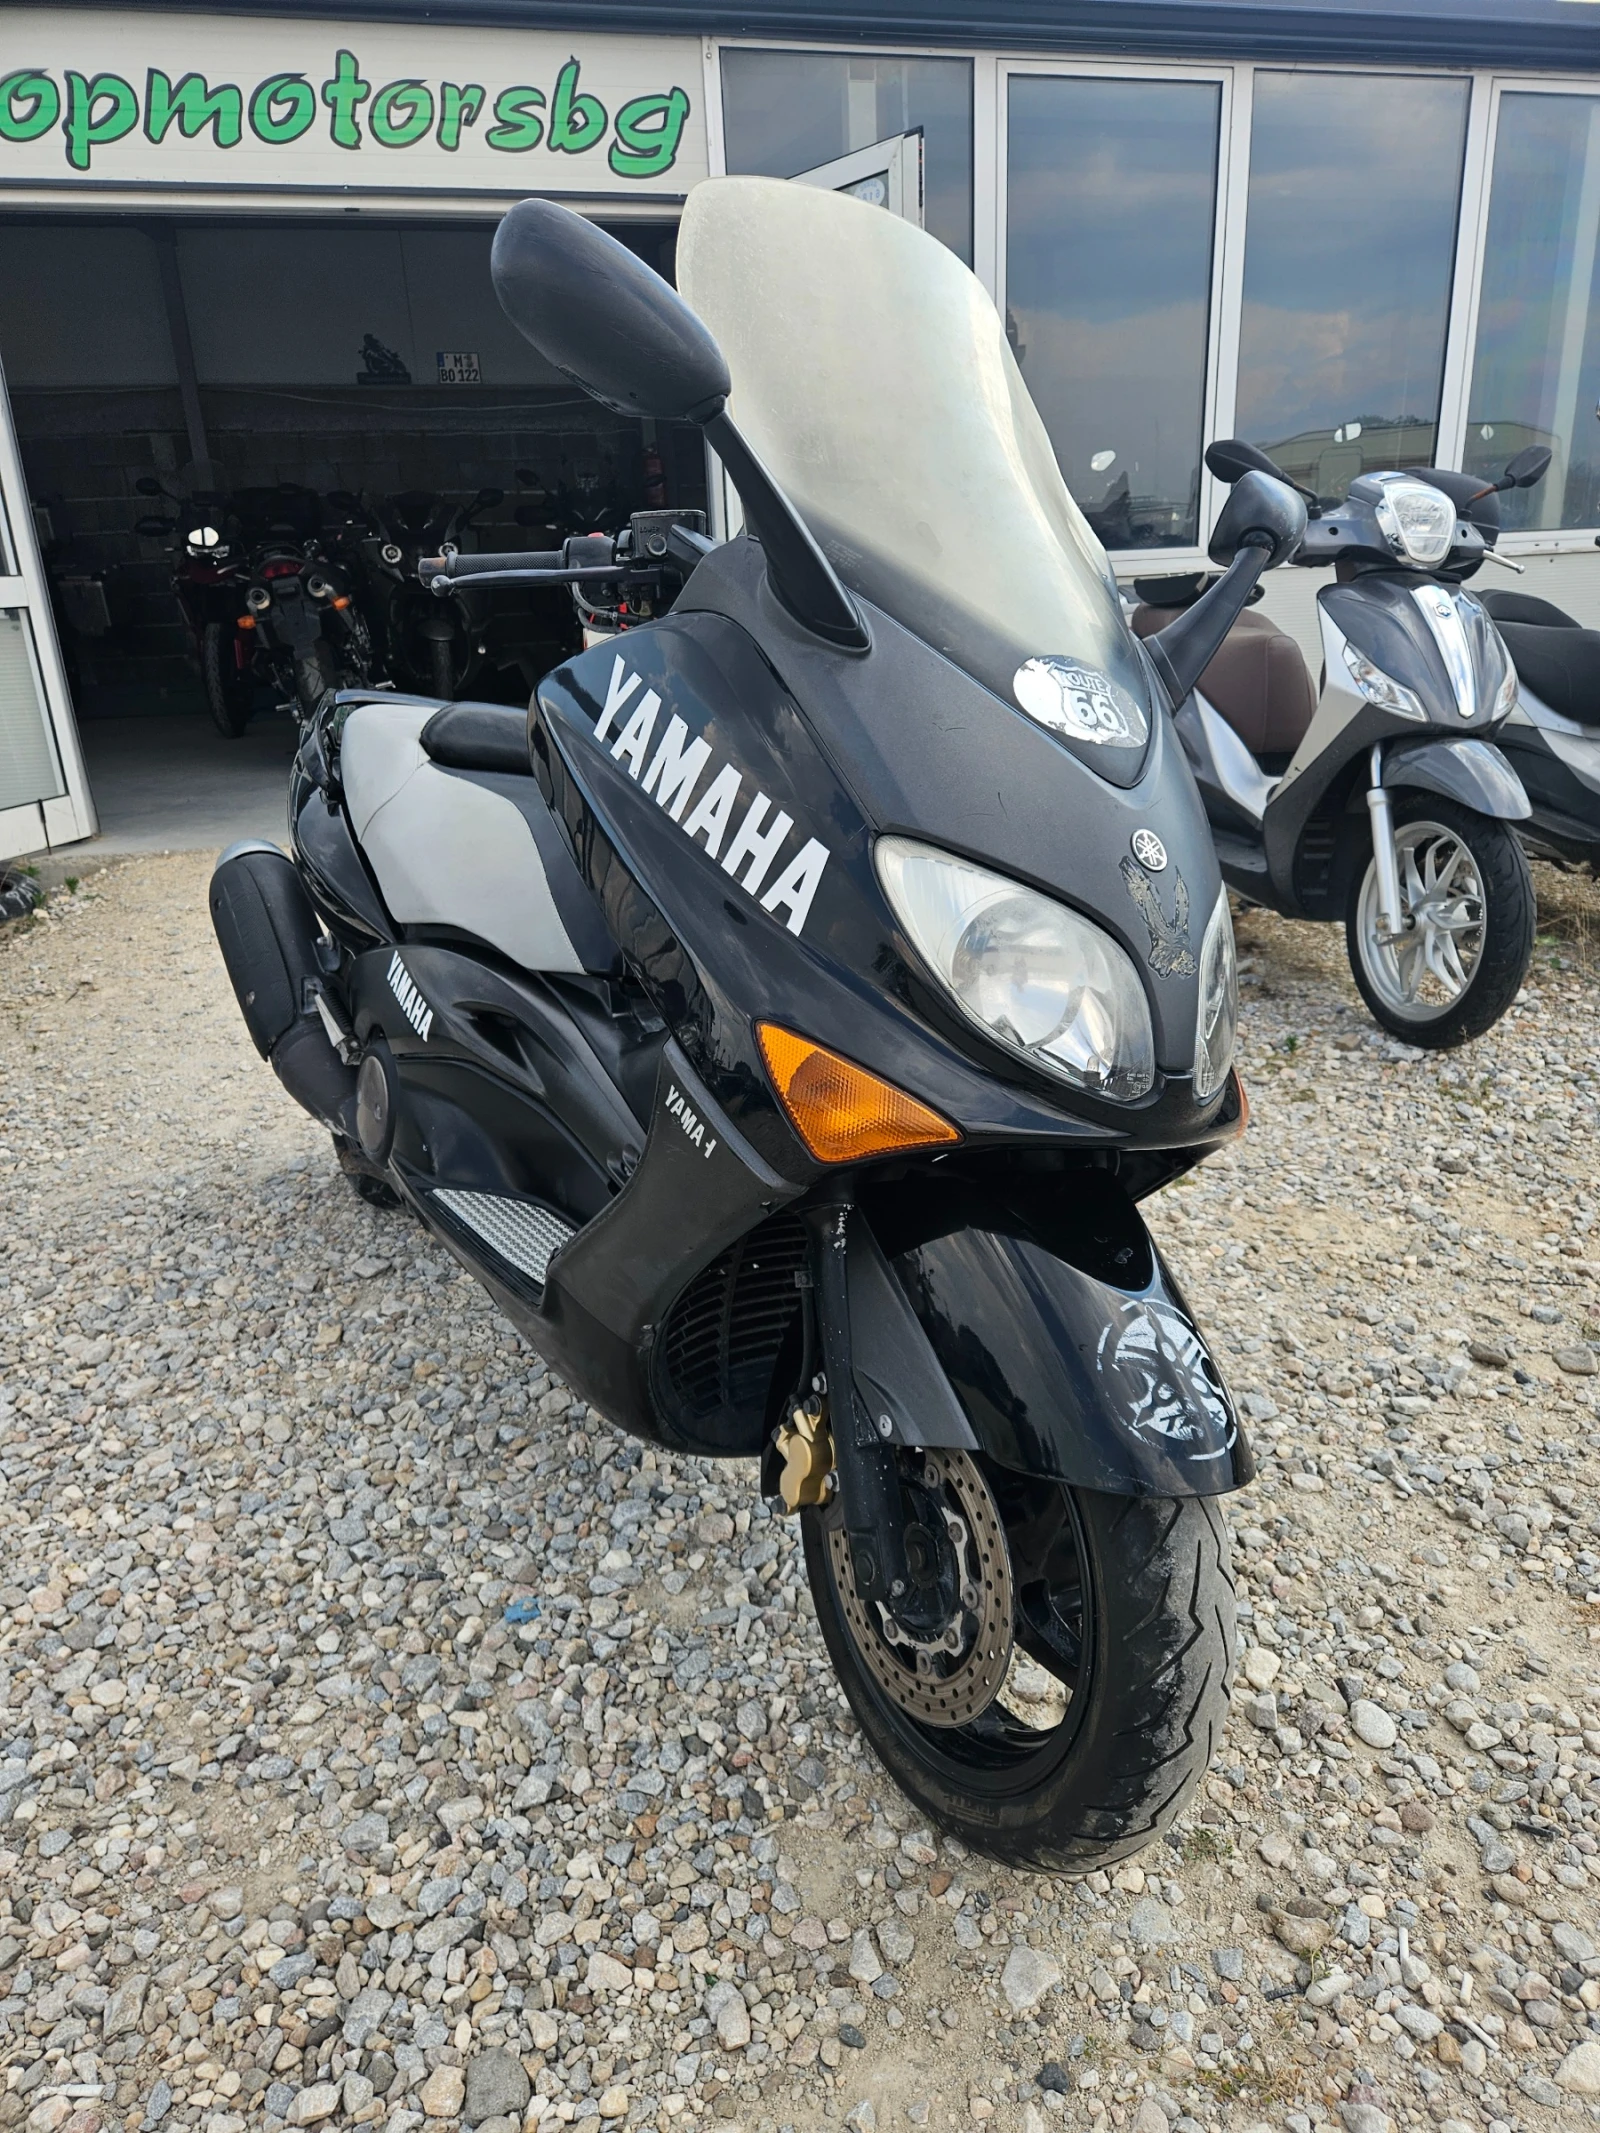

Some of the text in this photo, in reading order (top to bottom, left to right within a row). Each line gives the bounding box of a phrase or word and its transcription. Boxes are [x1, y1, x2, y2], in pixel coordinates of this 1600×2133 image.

[0, 49, 691, 179] opmotorsbg
[458, 369, 479, 382] 122
[1070, 691, 1119, 730] 66
[593, 653, 831, 937] YAMAHA
[387, 950, 434, 1043] YAMAHA
